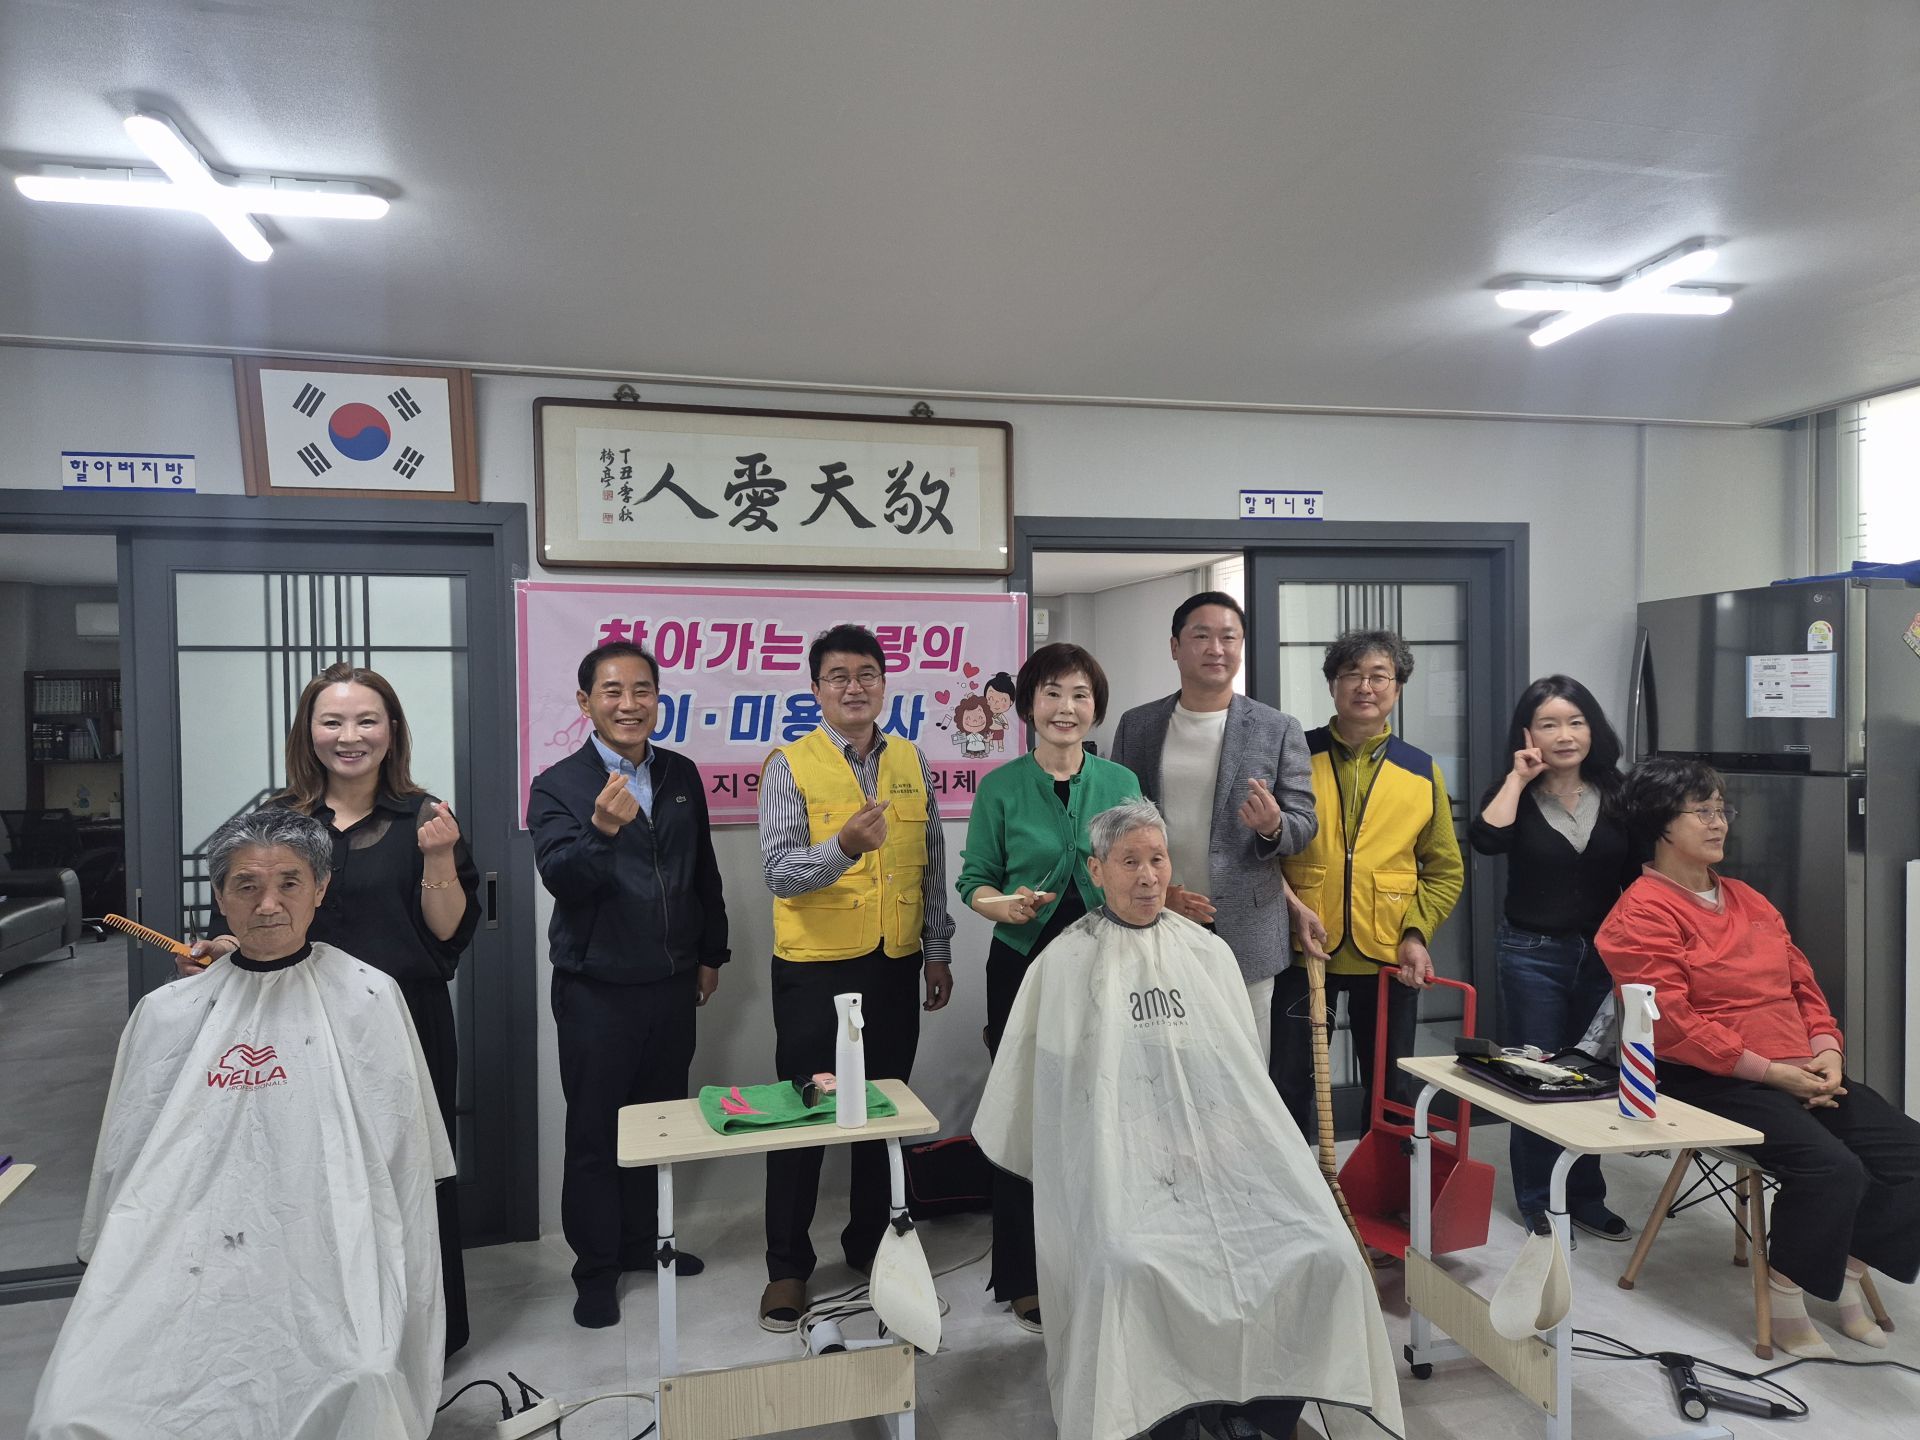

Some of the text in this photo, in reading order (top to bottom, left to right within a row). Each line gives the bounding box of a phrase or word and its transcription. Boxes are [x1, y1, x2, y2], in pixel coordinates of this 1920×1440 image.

[70, 460, 183, 484] 할아버지방
[1245, 496, 1315, 515] 할머니방
[834, 624, 965, 673] 랑의
[1129, 987, 1186, 1021] ams
[207, 1066, 287, 1089] WELLA
[226, 1080, 287, 1092] PROFESSIONALS
